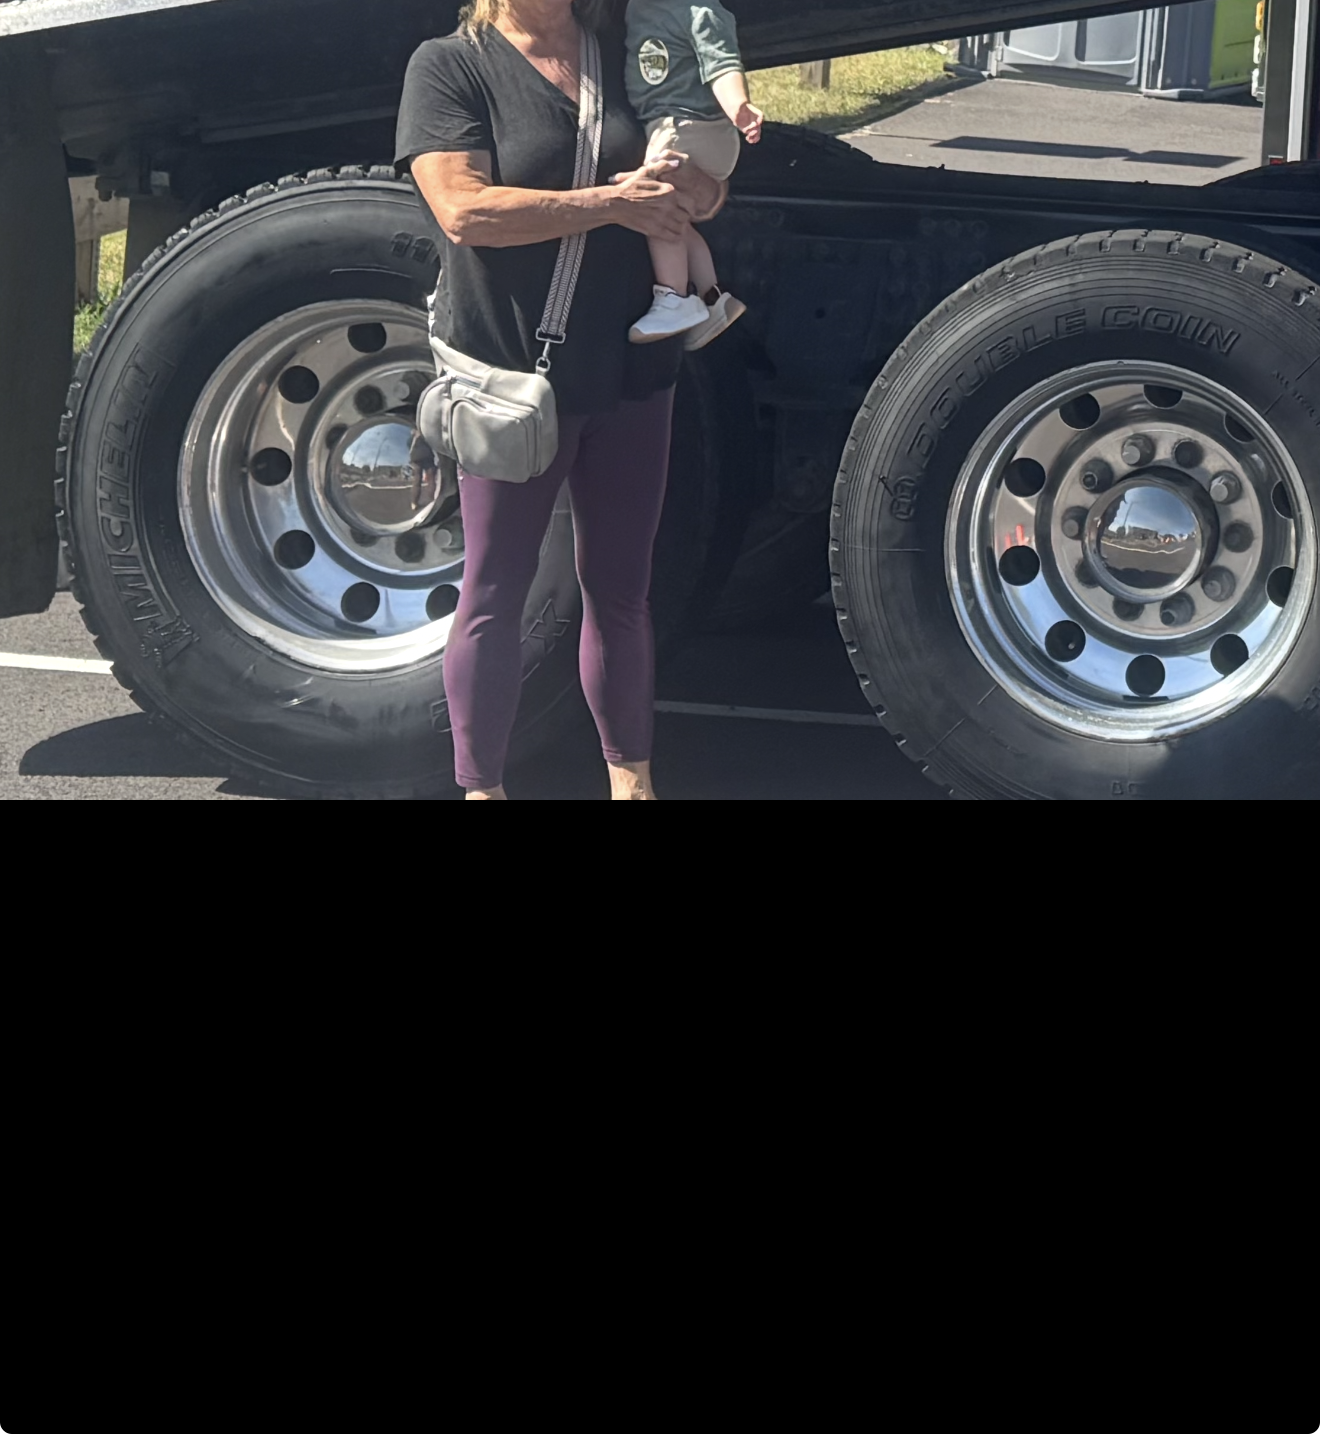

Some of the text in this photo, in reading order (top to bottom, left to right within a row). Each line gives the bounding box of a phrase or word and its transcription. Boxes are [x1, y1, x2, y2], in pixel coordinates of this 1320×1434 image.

[100, 347, 162, 621] MICHELIN
[907, 305, 1241, 458] DOUBLE COIN
